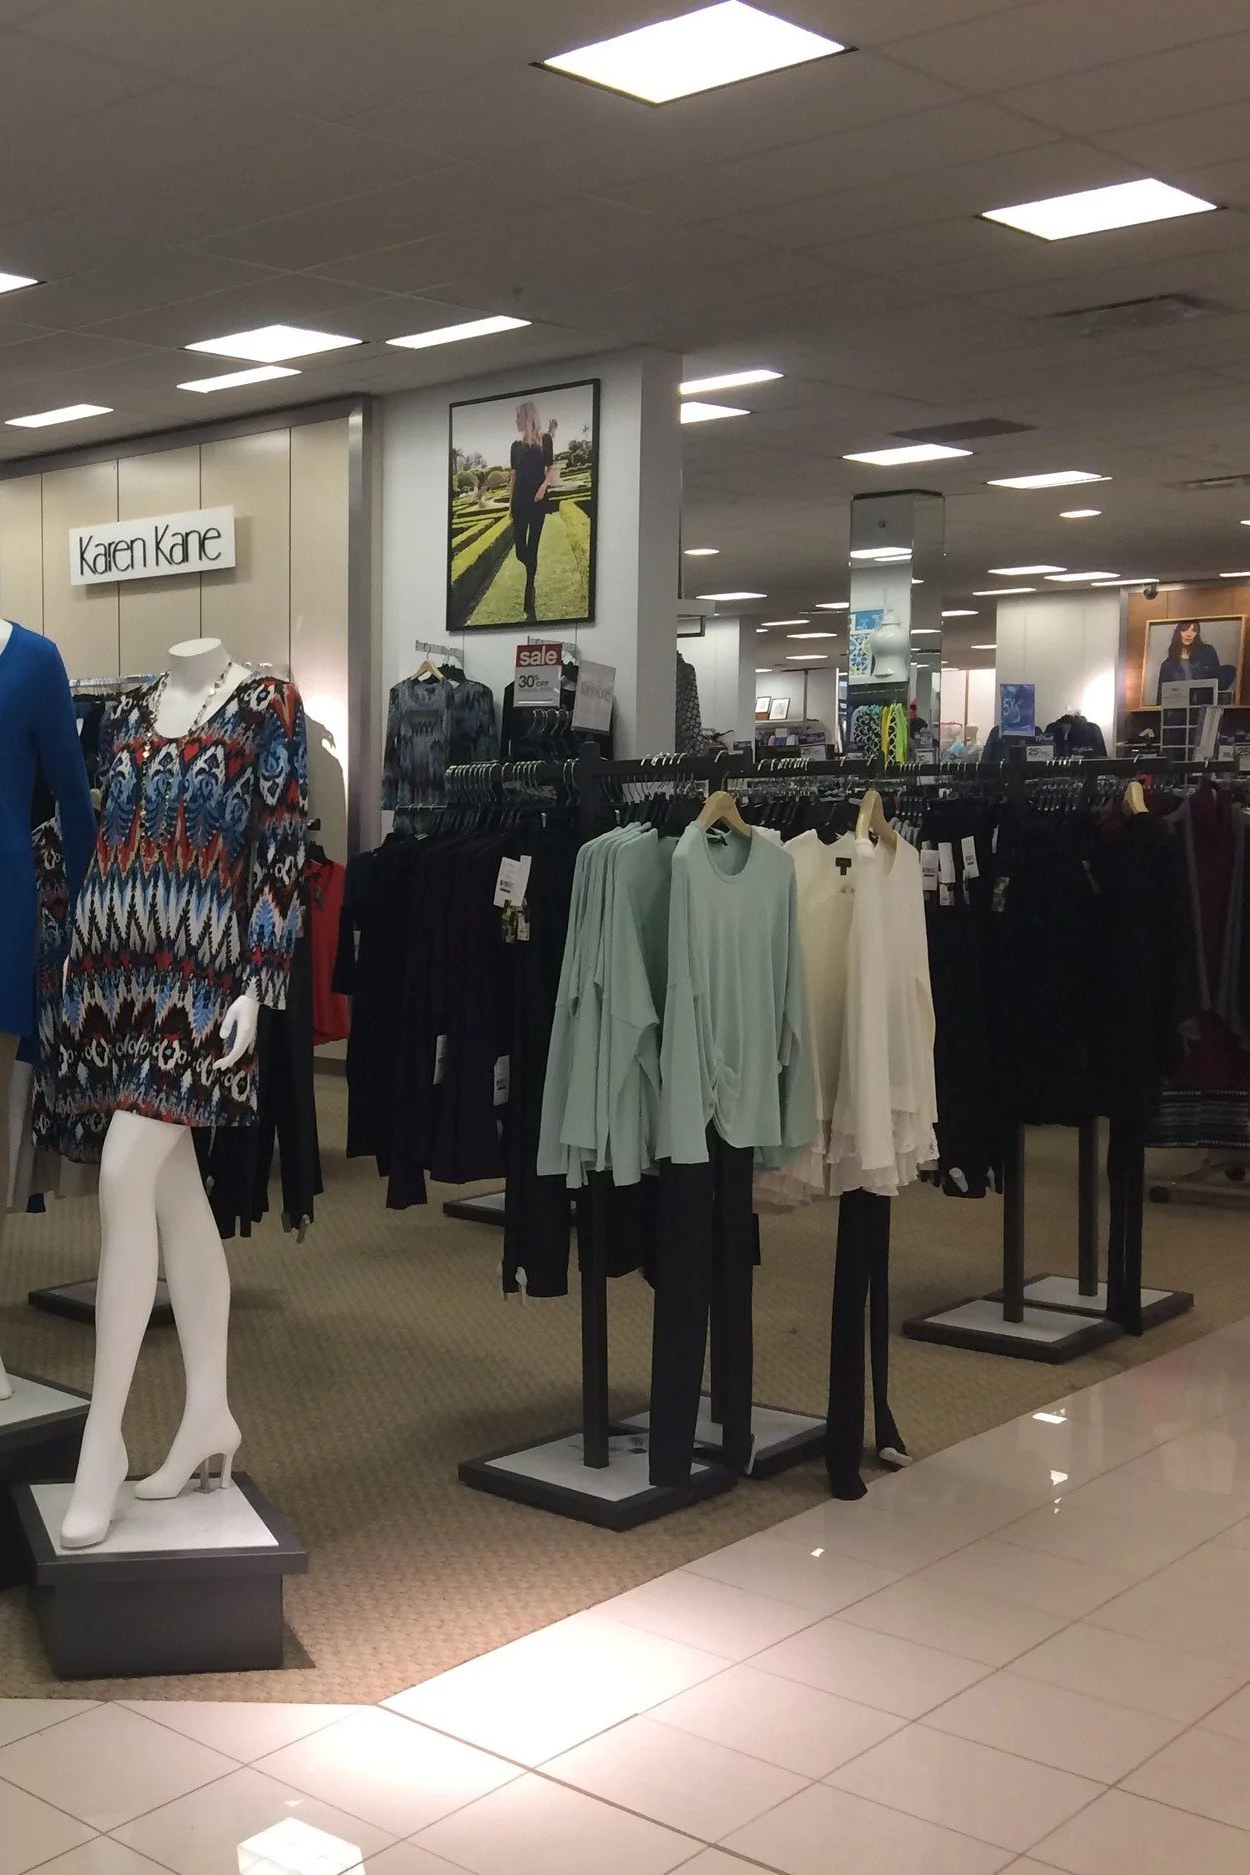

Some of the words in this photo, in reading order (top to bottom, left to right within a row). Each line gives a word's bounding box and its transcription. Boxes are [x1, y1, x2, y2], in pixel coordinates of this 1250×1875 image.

[79, 535, 147, 576] Karen
[154, 525, 222, 566] Kane
[519, 645, 558, 666] sale
